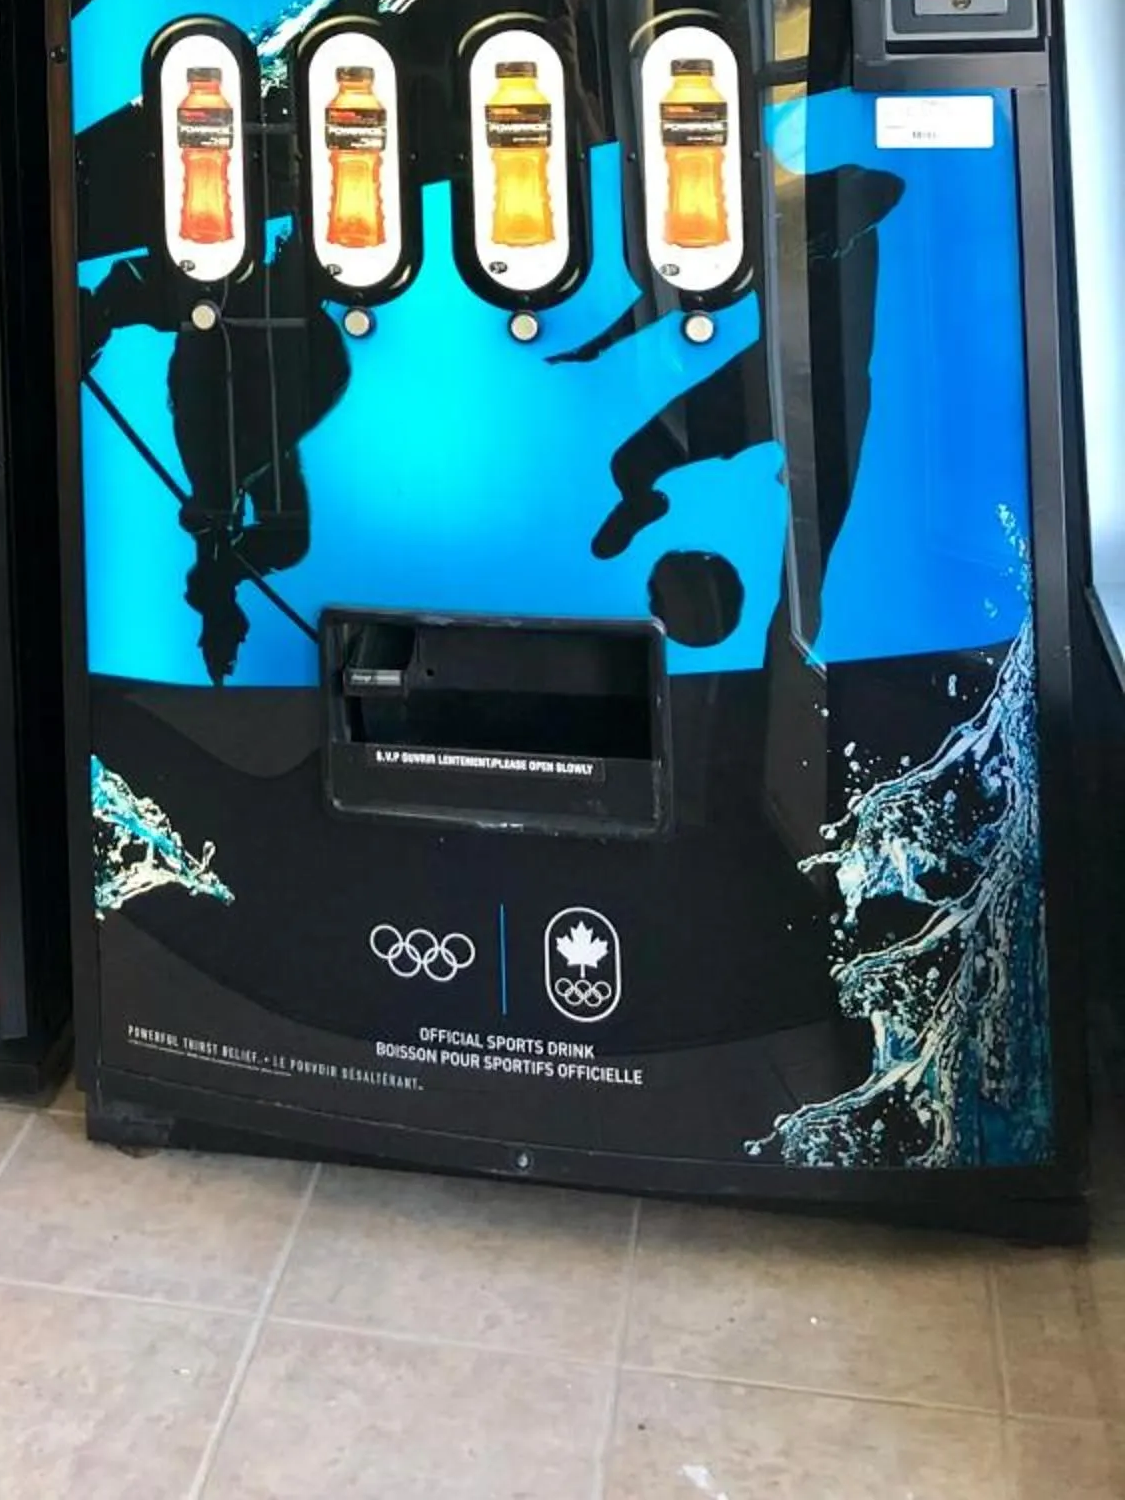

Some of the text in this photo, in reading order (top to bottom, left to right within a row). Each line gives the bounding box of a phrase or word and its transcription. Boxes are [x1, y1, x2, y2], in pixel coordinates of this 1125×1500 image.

[401, 752, 435, 764] OUVRIR
[529, 760, 554, 772] OPEN
[556, 761, 594, 775] SLOWLY
[128, 1024, 178, 1047] POWERFUL
[183, 1037, 218, 1056] THIRST
[290, 1058, 338, 1077] POUVOIR
[420, 1027, 595, 1060] OFFICIAL SPORTS DRINK
[376, 1041, 644, 1085] BOISSON POUR SPORTIFS OFFICIELLE
